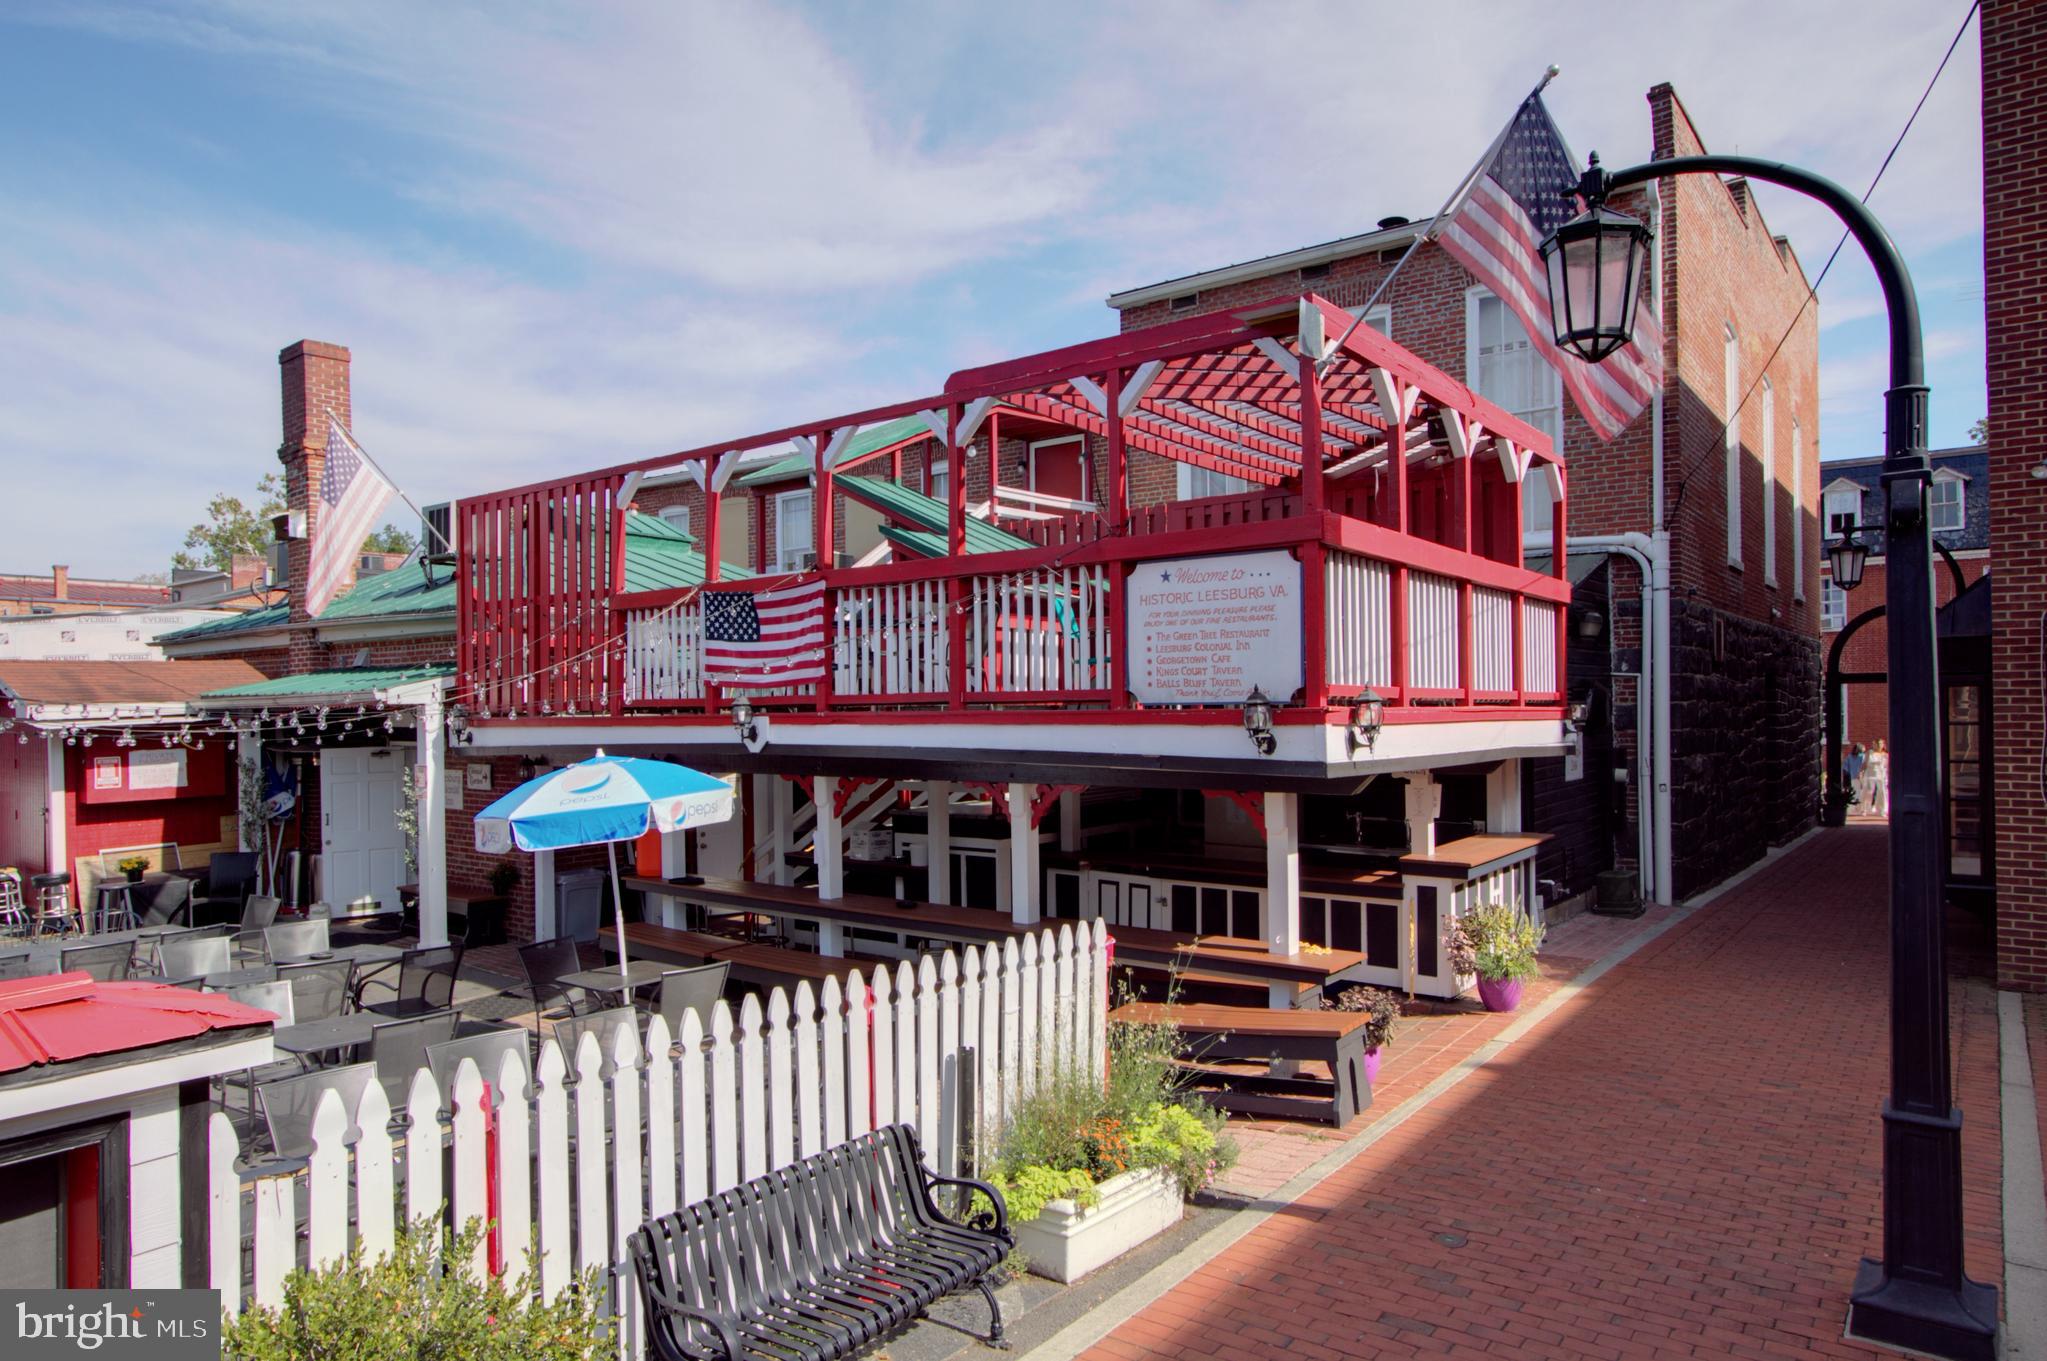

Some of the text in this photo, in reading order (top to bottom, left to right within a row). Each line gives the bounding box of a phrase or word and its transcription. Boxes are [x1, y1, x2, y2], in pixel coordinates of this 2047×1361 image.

[1174, 567, 1229, 584] Welcome
[1231, 567, 1245, 580] to
[1139, 591, 1194, 606] HISTORIC
[1198, 586, 1265, 602] LEESBURG
[1155, 643, 1192, 654] LEESBURG
[1194, 641, 1233, 652] COLONIAL
[1155, 652, 1231, 665] GEORGETOWN CAFE
[1156, 666, 1179, 678] KINGS
[1181, 665, 1208, 677] COURT
[1156, 678, 1180, 689] BALLS
[1183, 677, 1207, 688] BLUFF
[687, 800, 718, 820] pepsi
